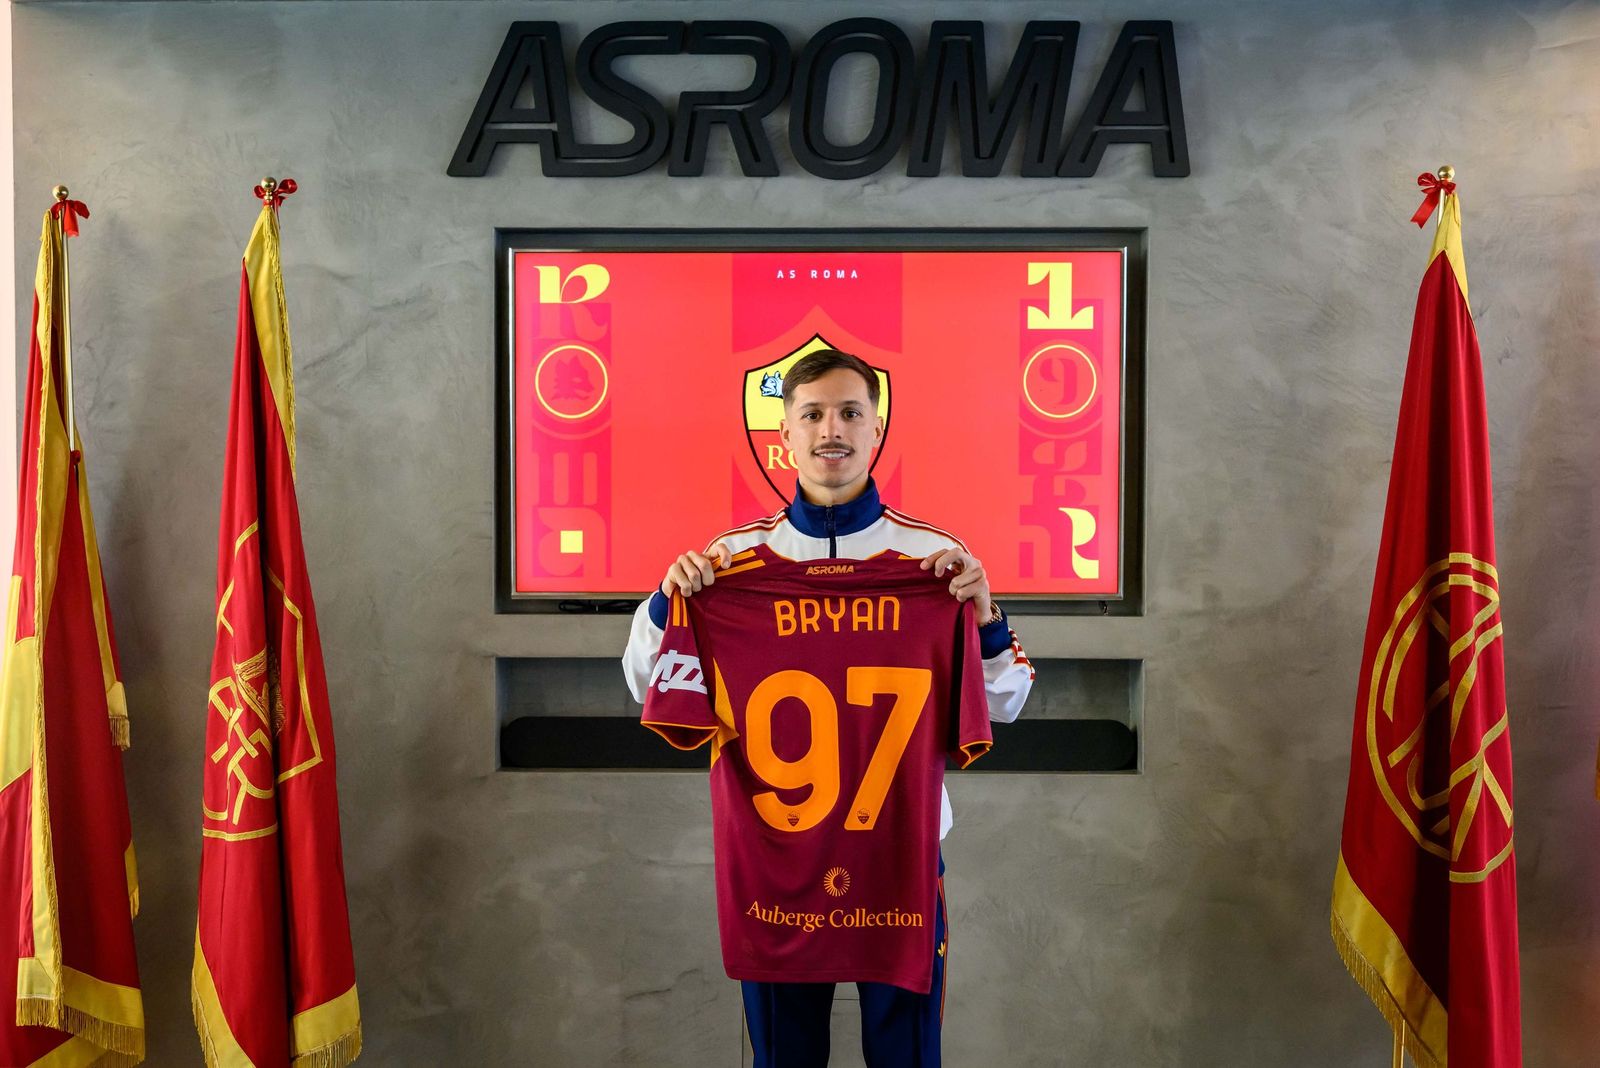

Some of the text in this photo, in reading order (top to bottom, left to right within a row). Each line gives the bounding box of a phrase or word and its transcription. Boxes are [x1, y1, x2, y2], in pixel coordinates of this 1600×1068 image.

[776, 269, 858, 279] AS ROMA
[774, 596, 900, 637] BRYAN
[745, 666, 932, 833] 97
[746, 900, 923, 932] Auberge Collection
